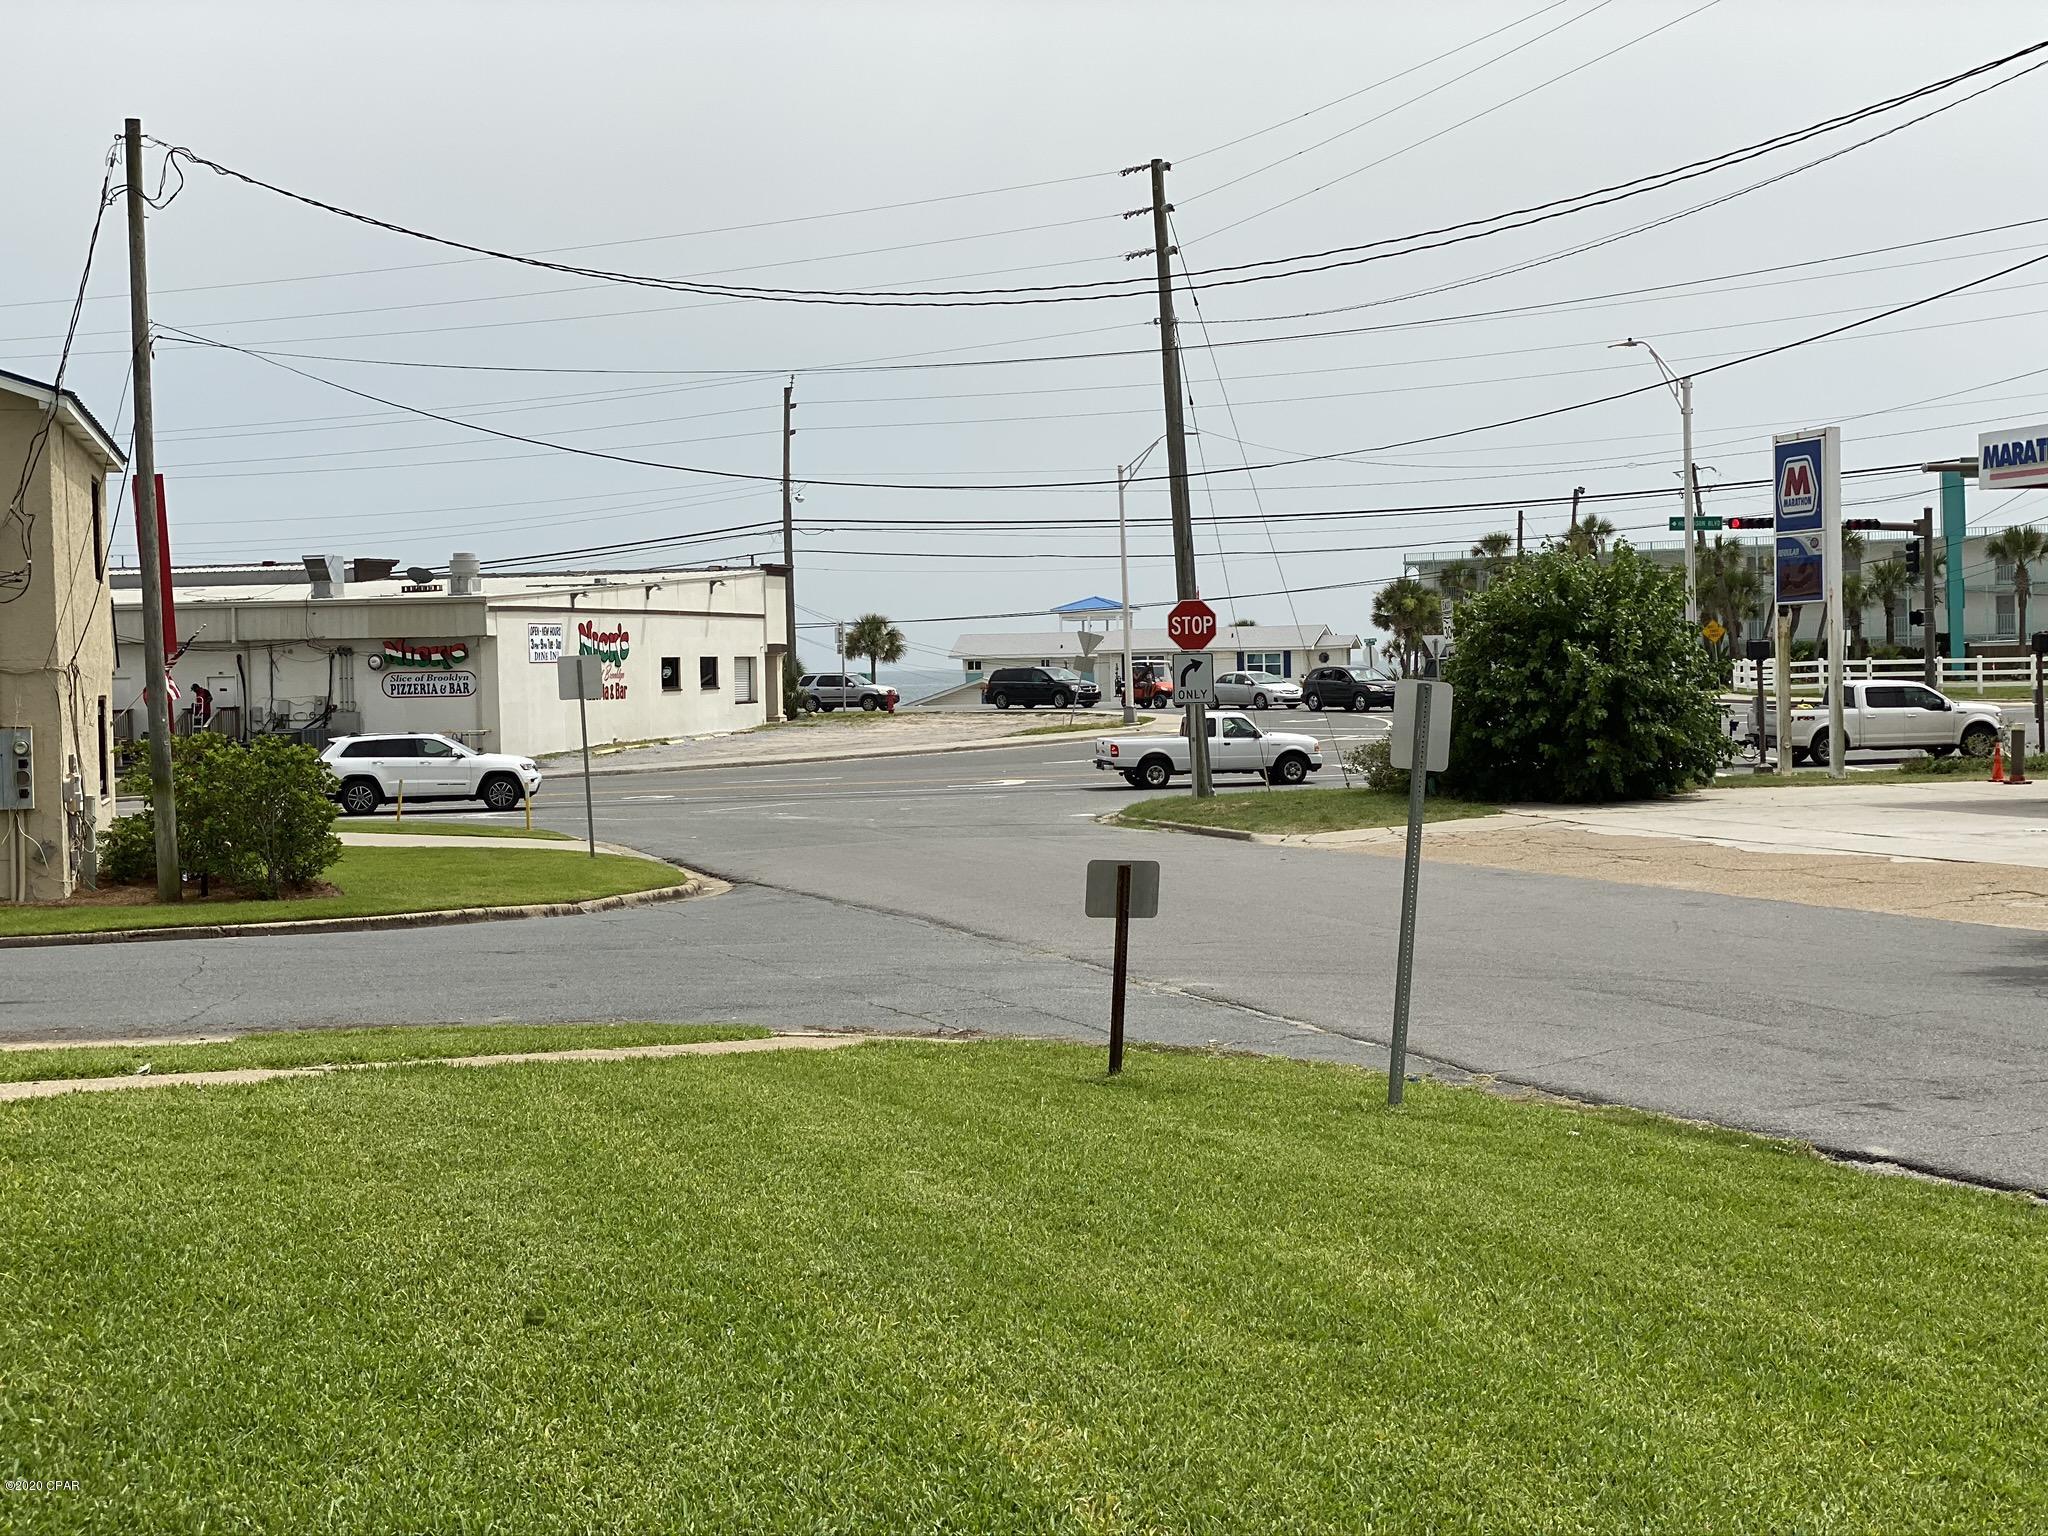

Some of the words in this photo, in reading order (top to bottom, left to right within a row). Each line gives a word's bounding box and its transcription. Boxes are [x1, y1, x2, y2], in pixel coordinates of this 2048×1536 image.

[1982, 437, 2048, 470] MARAT
[1784, 465, 1811, 497] M
[1783, 496, 1812, 508] MARATHON
[530, 626, 539, 636] OPEN
[550, 626, 561, 636] HOURS
[1171, 616, 1213, 635] STOP
[534, 651, 548, 661] DINE
[390, 674, 413, 683] Slice
[416, 673, 426, 682] of
[426, 673, 469, 683] Brooklyn
[390, 683, 438, 696] PIZZERIA
[449, 682, 470, 694] BAR
[615, 682, 628, 700] Bar
[1178, 689, 1208, 700] ONLY
